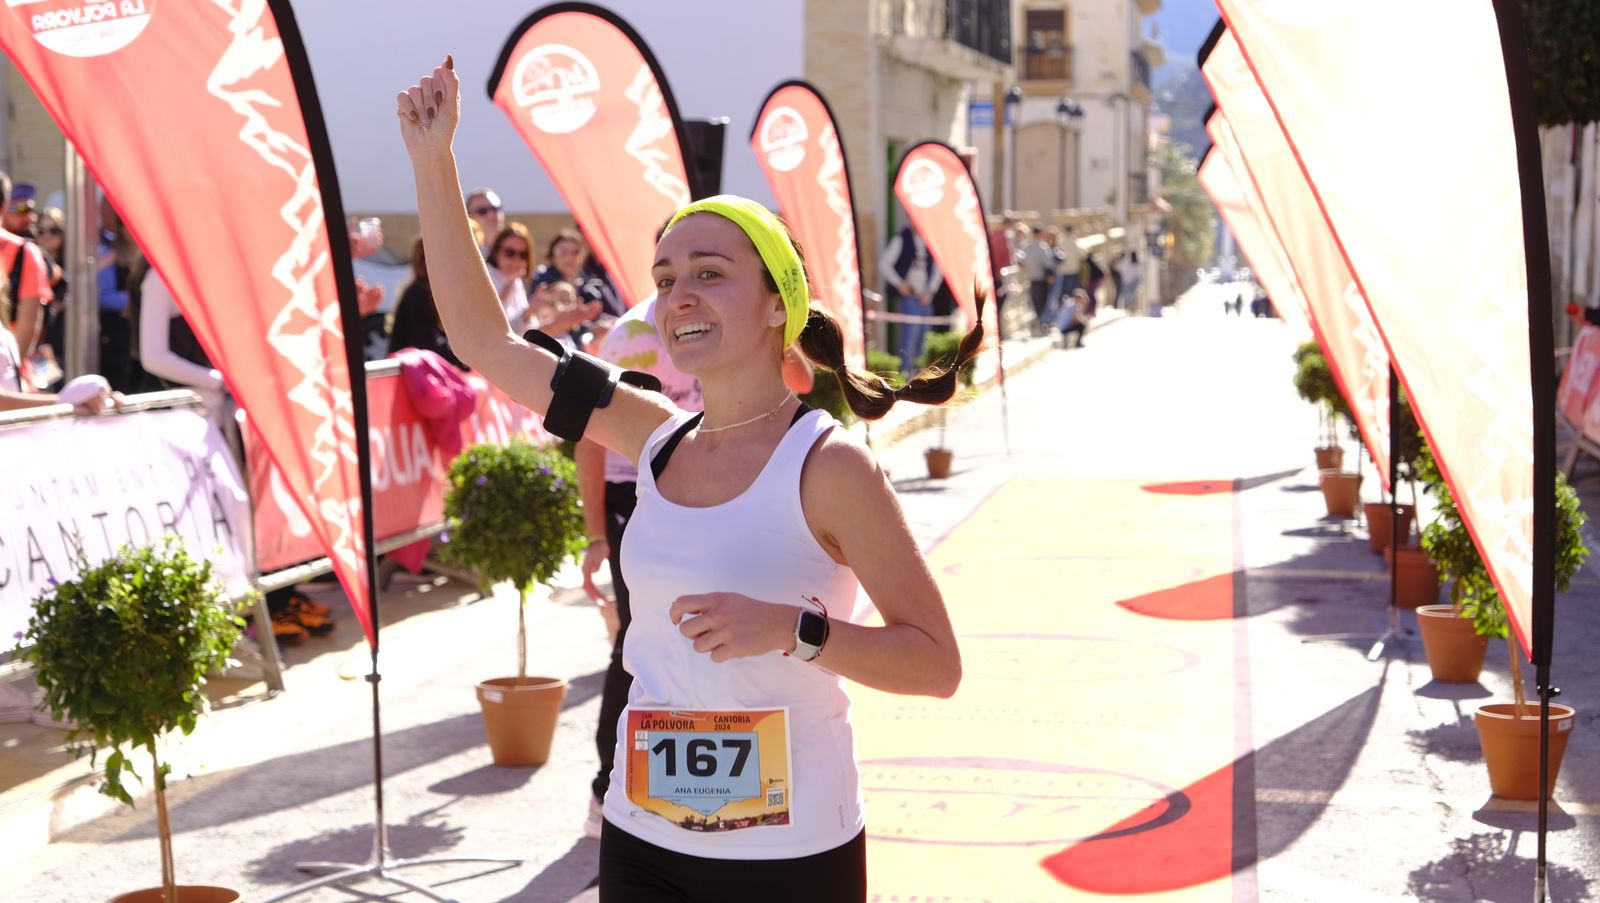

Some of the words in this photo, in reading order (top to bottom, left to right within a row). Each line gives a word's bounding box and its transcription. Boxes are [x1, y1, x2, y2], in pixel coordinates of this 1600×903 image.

[641, 720, 651, 729] LA
[653, 717, 696, 730] PÓLVORA
[713, 715, 751, 723] CANTORIA
[652, 738, 752, 777] 167
[694, 787, 731, 795] EUGENIA
